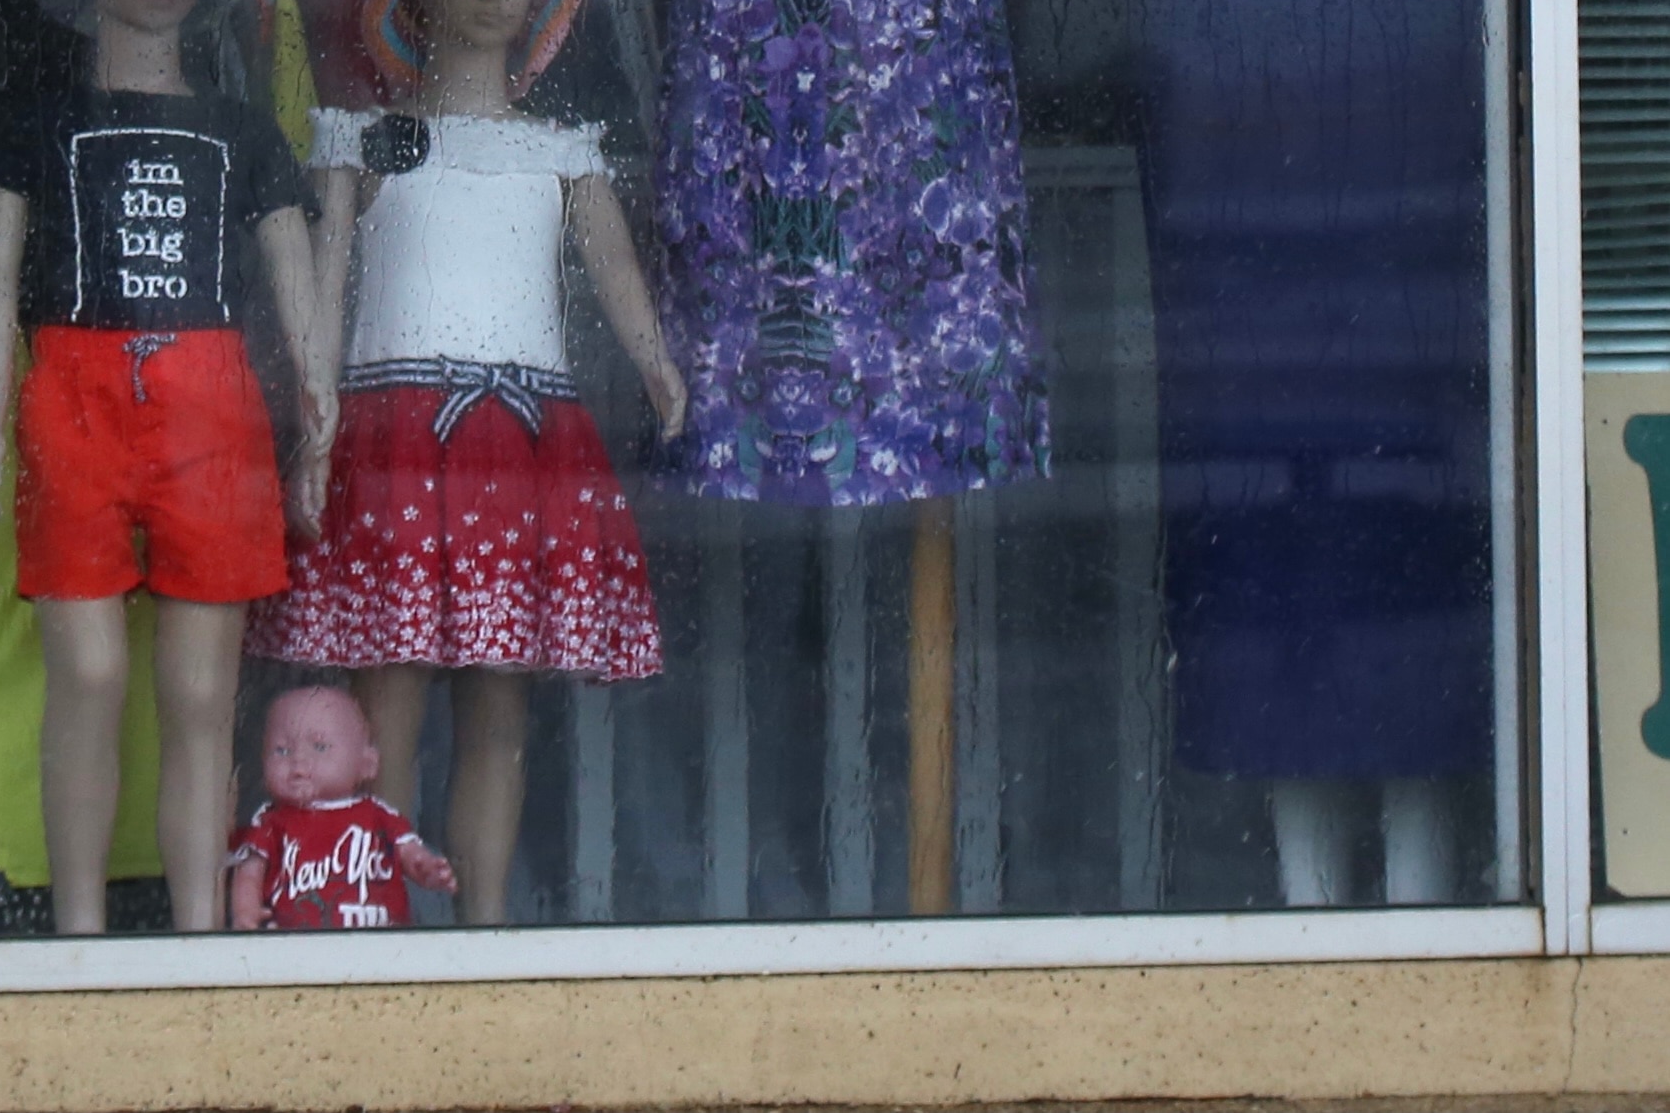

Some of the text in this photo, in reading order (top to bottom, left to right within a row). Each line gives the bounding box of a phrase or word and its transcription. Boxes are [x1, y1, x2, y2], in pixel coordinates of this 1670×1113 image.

[122, 189, 186, 219] the
[118, 229, 185, 262] big
[119, 269, 188, 298] bro
[272, 833, 330, 906] New
